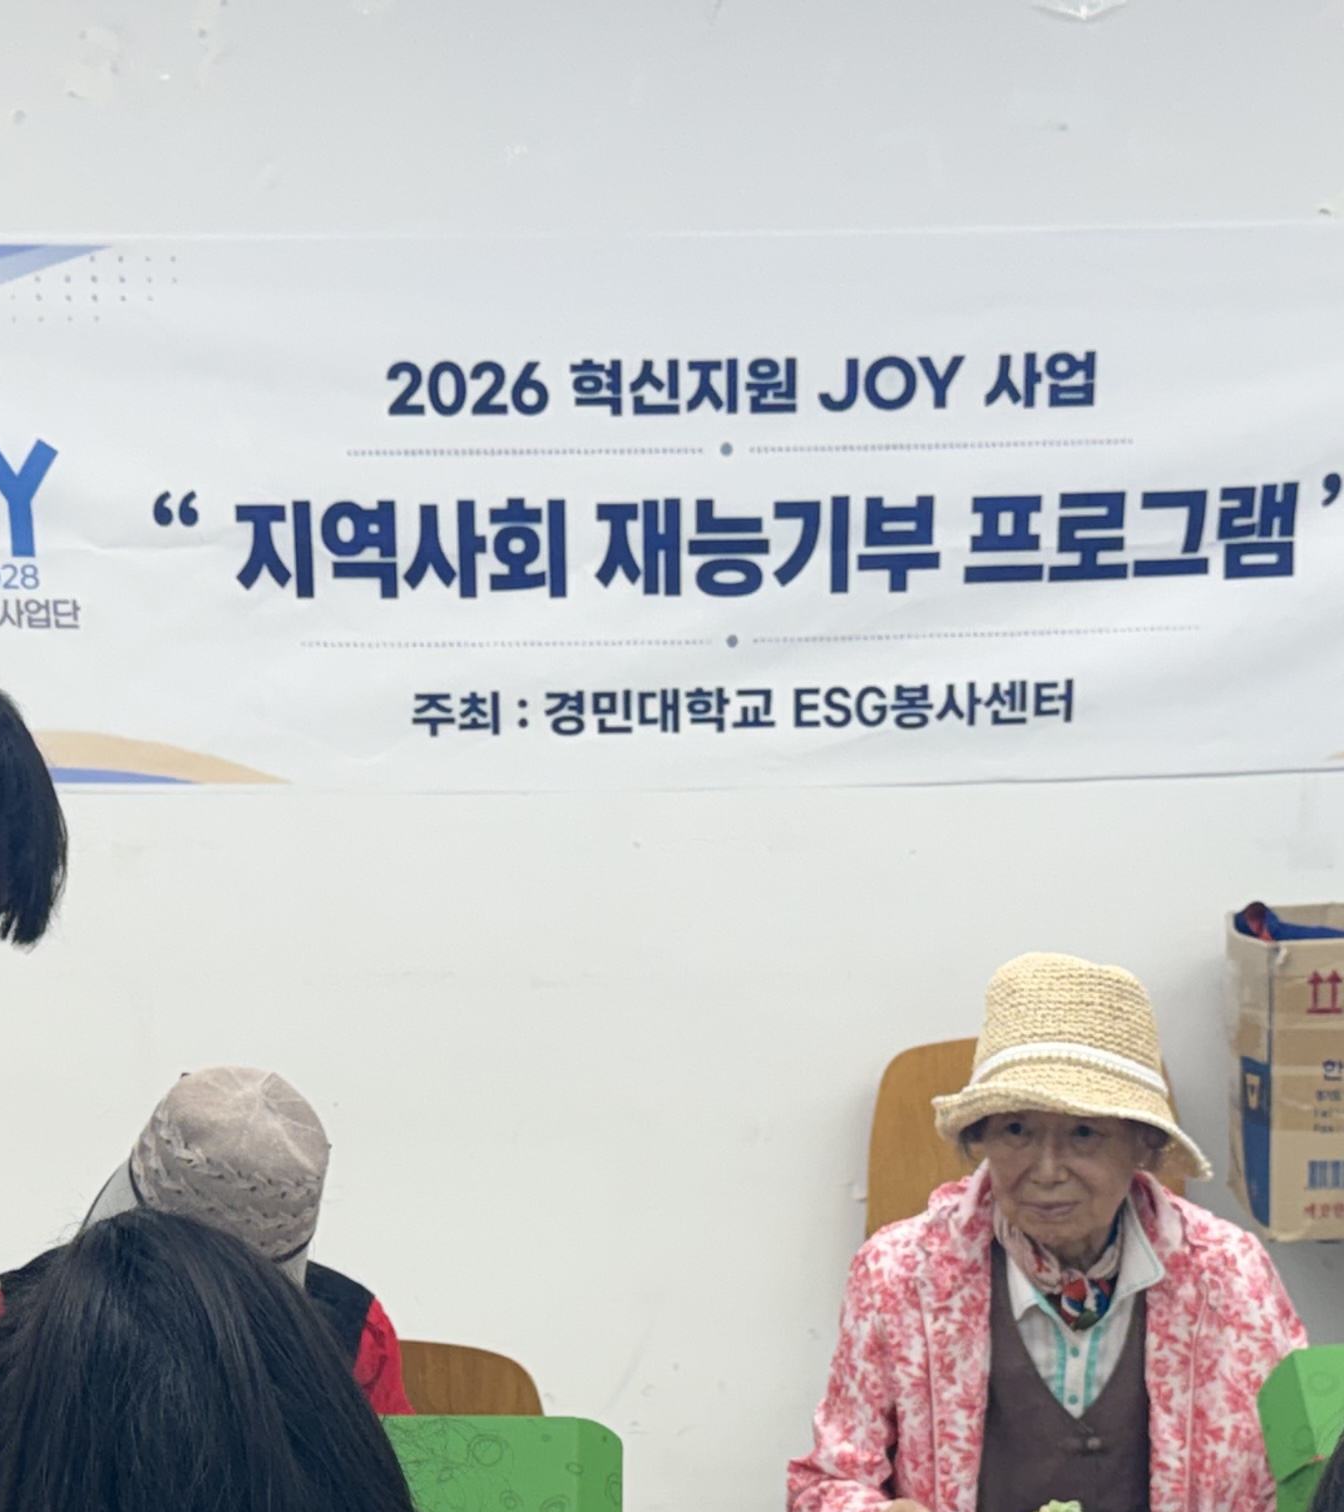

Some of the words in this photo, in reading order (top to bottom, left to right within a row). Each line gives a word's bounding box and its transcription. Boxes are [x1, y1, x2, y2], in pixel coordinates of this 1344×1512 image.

[386, 360, 548, 417] 2026
[570, 357, 798, 417] 혁신지원
[819, 355, 965, 412] JOY
[984, 350, 1097, 409] 사업
[235, 499, 567, 600] 지역사회
[595, 494, 940, 598] 재능기부
[964, 480, 1299, 585] 프로그램
[412, 690, 500, 736] 주최
[544, 687, 774, 736] 경민대학교
[793, 678, 1074, 729] ESG봉사센터
